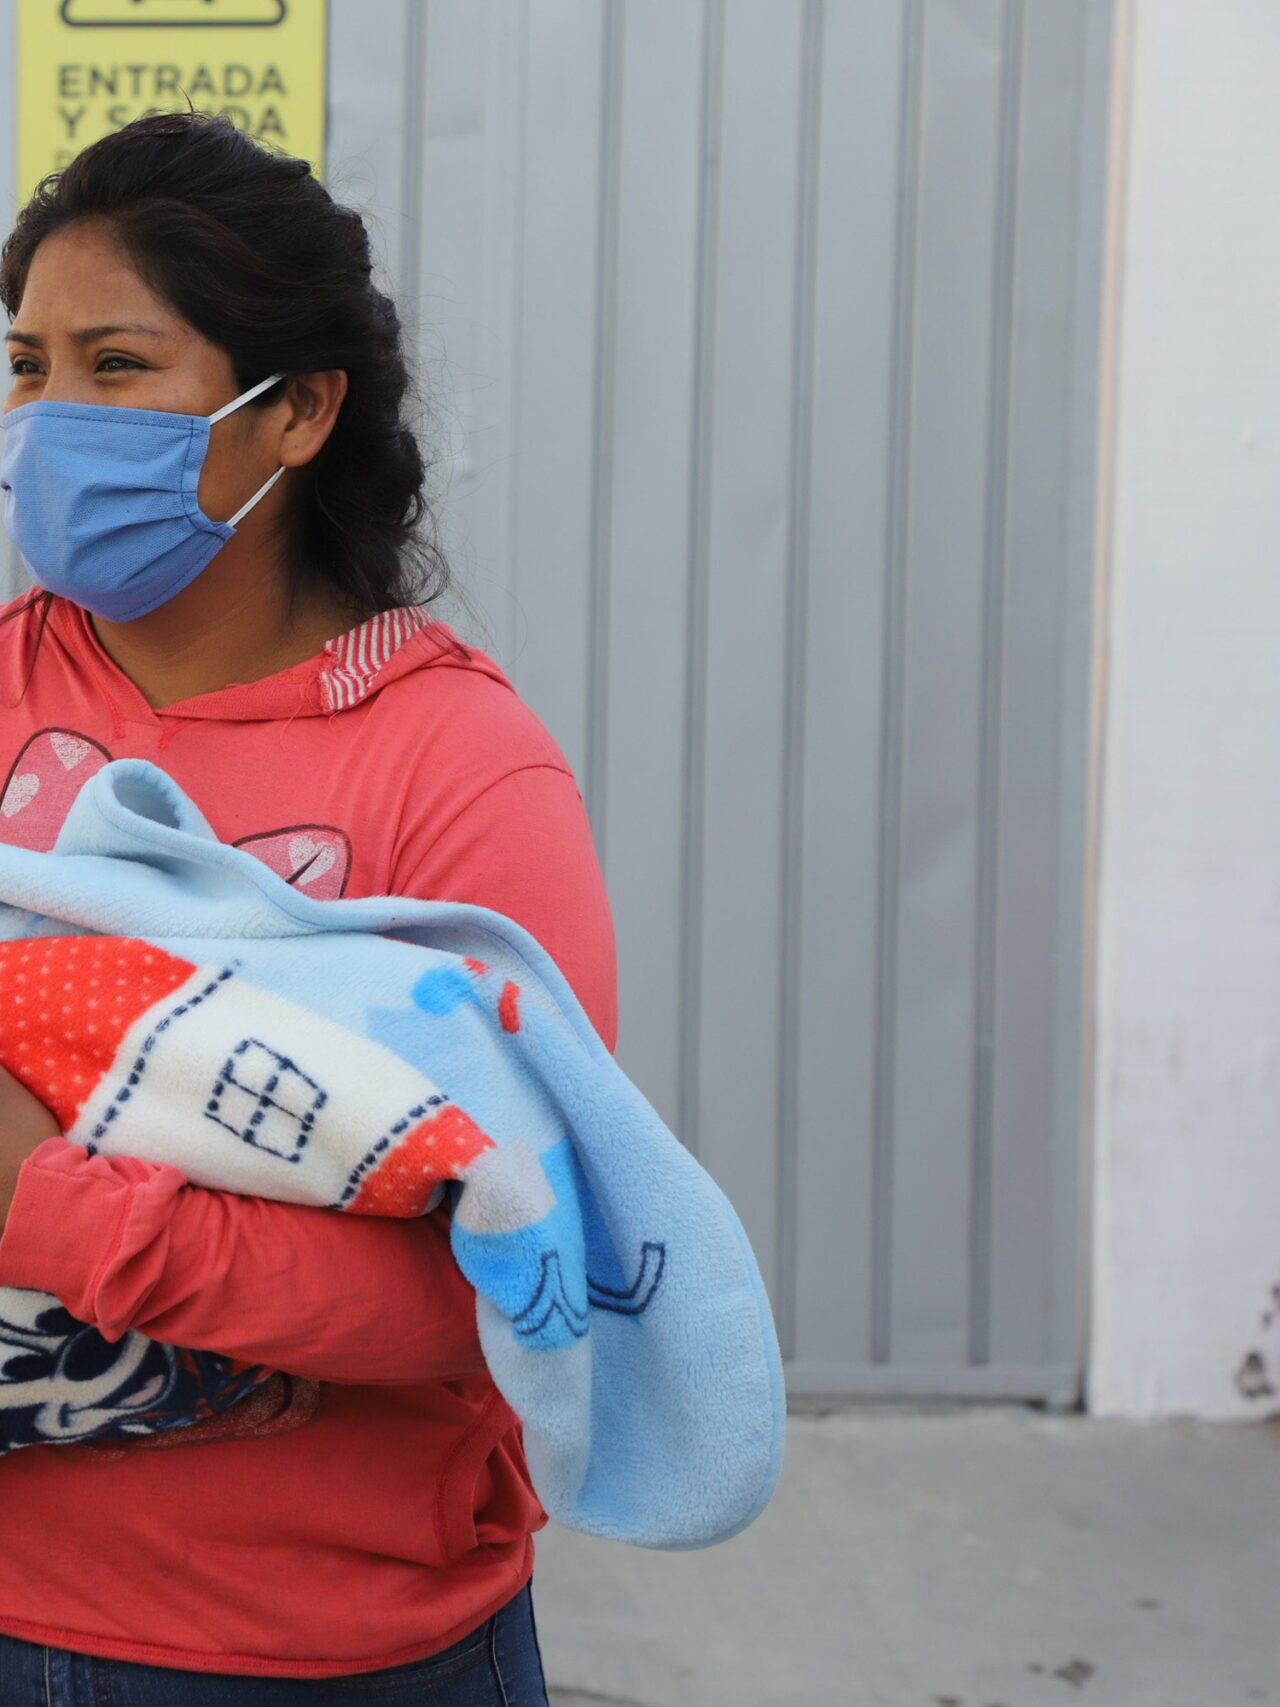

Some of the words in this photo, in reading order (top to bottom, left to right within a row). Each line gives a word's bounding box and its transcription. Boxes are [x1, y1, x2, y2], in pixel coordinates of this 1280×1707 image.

[57, 64, 287, 97] ENTRADA
[56, 106, 87, 137] Y
[107, 106, 288, 138] SDA
